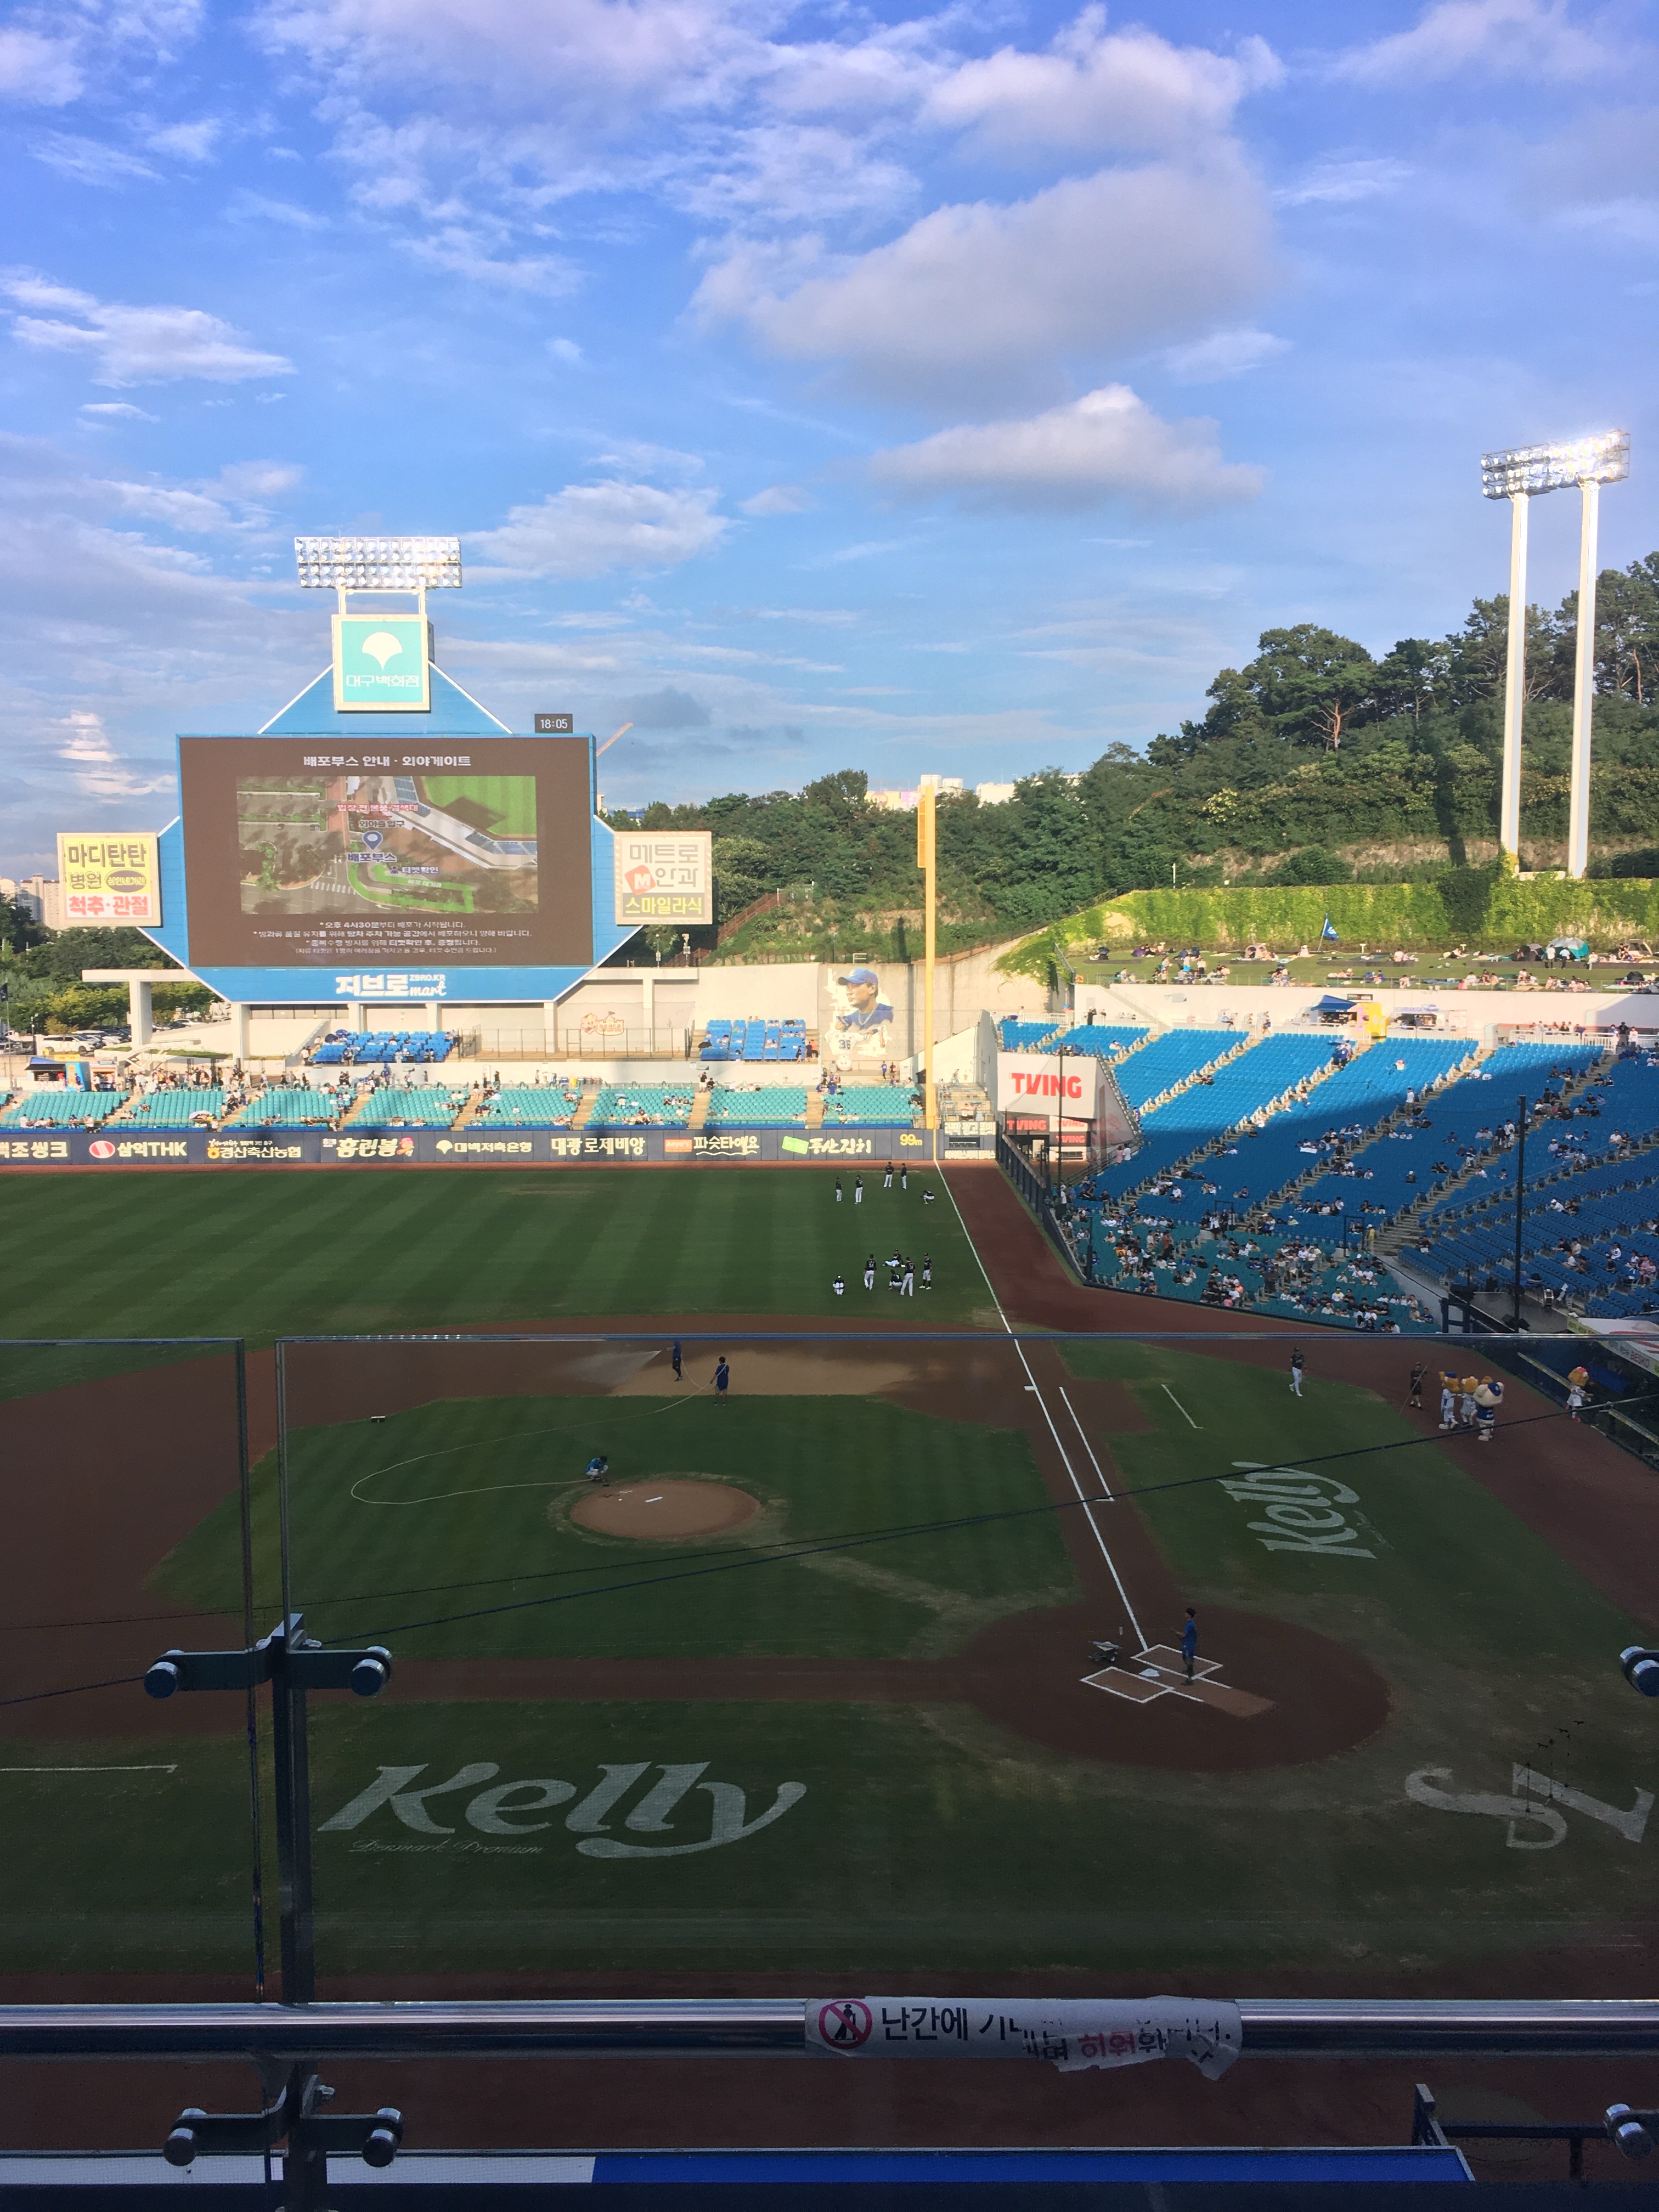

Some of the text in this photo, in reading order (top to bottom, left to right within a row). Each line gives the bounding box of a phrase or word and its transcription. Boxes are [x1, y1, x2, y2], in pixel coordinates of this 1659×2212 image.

[346, 675, 420, 687] 대구백화점
[540, 719, 568, 729] 18:05
[303, 755, 471, 766] 배포부스 안내 외야게이트
[66, 842, 146, 868] 마디탄탄
[347, 853, 397, 862] 배포부스
[630, 844, 698, 864] 메트로
[69, 871, 101, 890] 병원
[655, 868, 699, 887] 안과
[69, 895, 149, 916] 척추·관절
[625, 897, 702, 915] 스마일라식
[336, 974, 409, 996] 지브로
[410, 981, 447, 996] mart
[838, 1039, 851, 1050] 36
[1009, 1073, 1082, 1099] TVING
[1007, 1119, 1047, 1130] TVING
[336, 1138, 398, 1158] 홈런볼
[454, 1141, 532, 1153] 대백저축은행
[551, 1137, 646, 1155] 대광 로제비앙
[900, 1133, 923, 1146] 99m
[117, 1142, 187, 1157] 삼익THK
[220, 1146, 301, 1158] 경산축산농협
[1216, 1461, 1377, 1559] Kelly
[317, 1760, 808, 1859] Kelly
[882, 2007, 968, 2041] 난간에
